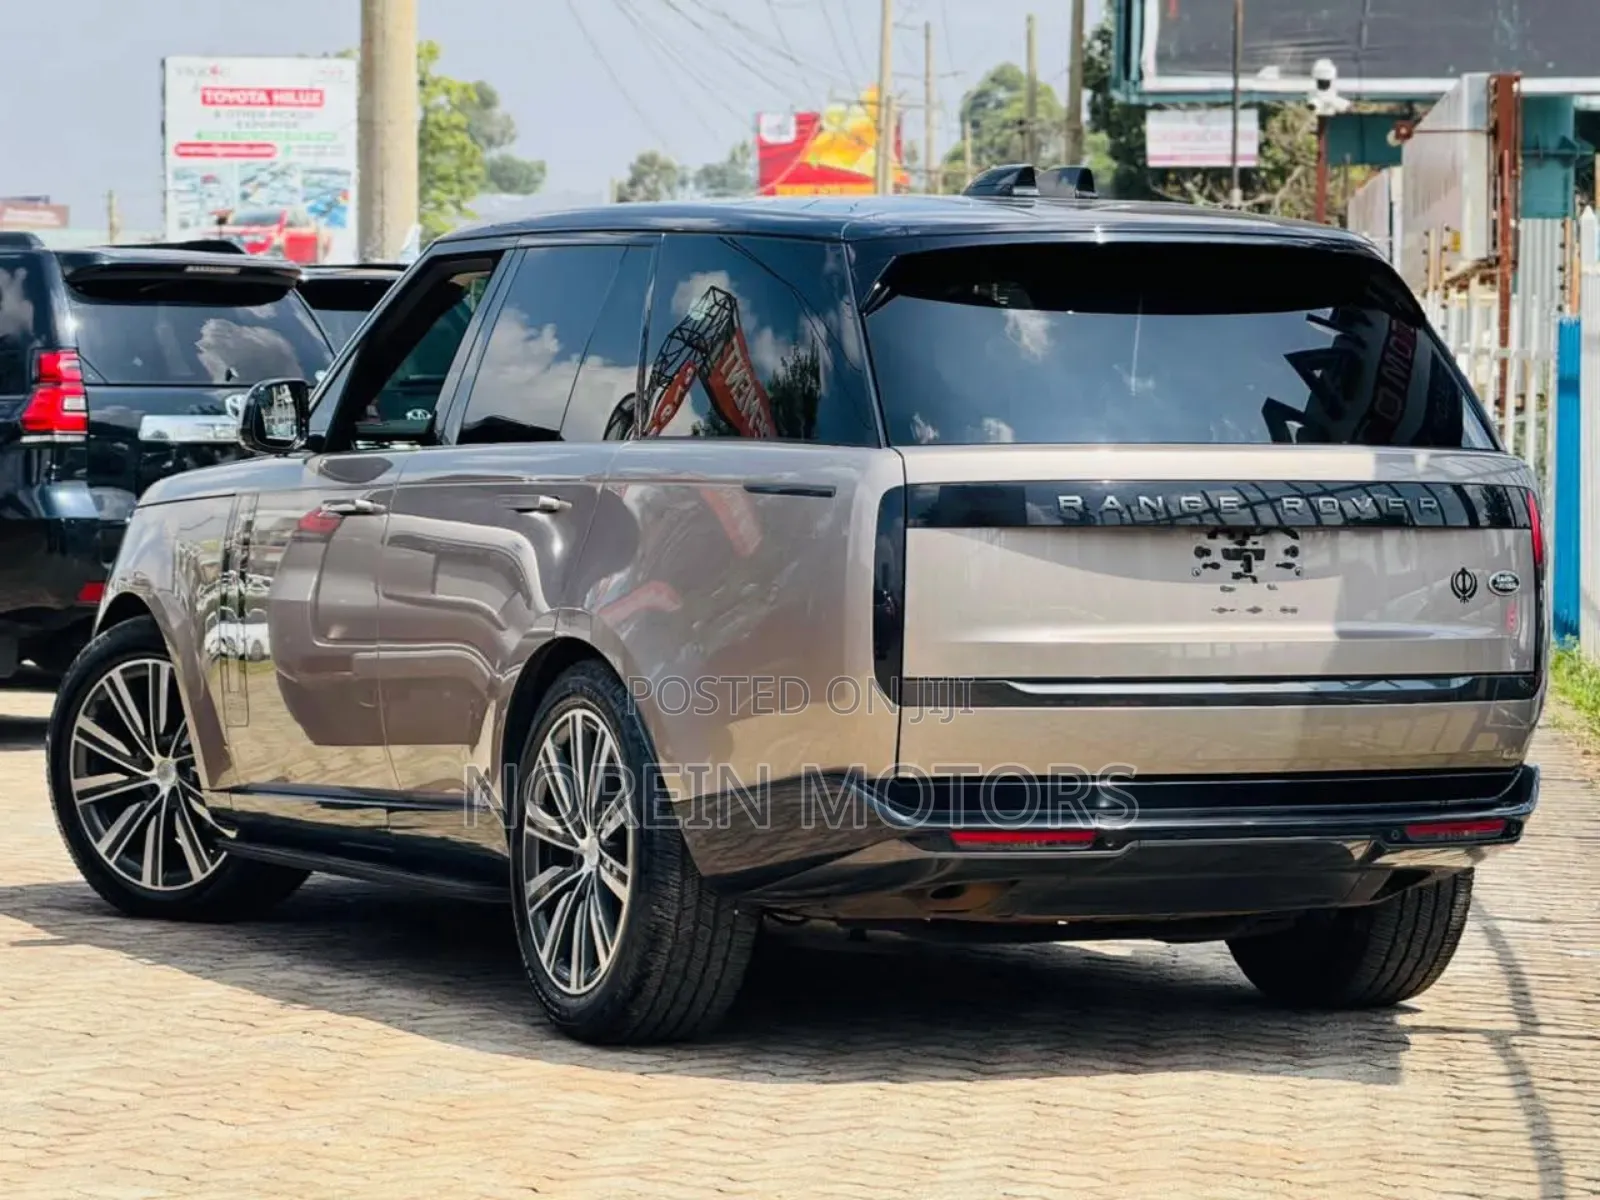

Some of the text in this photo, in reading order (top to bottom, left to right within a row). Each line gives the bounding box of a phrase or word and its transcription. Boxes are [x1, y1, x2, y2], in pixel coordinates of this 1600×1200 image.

[204, 88, 322, 105] TOYOTA HILUX
[1058, 495, 1439, 514] RANGE ROVER
